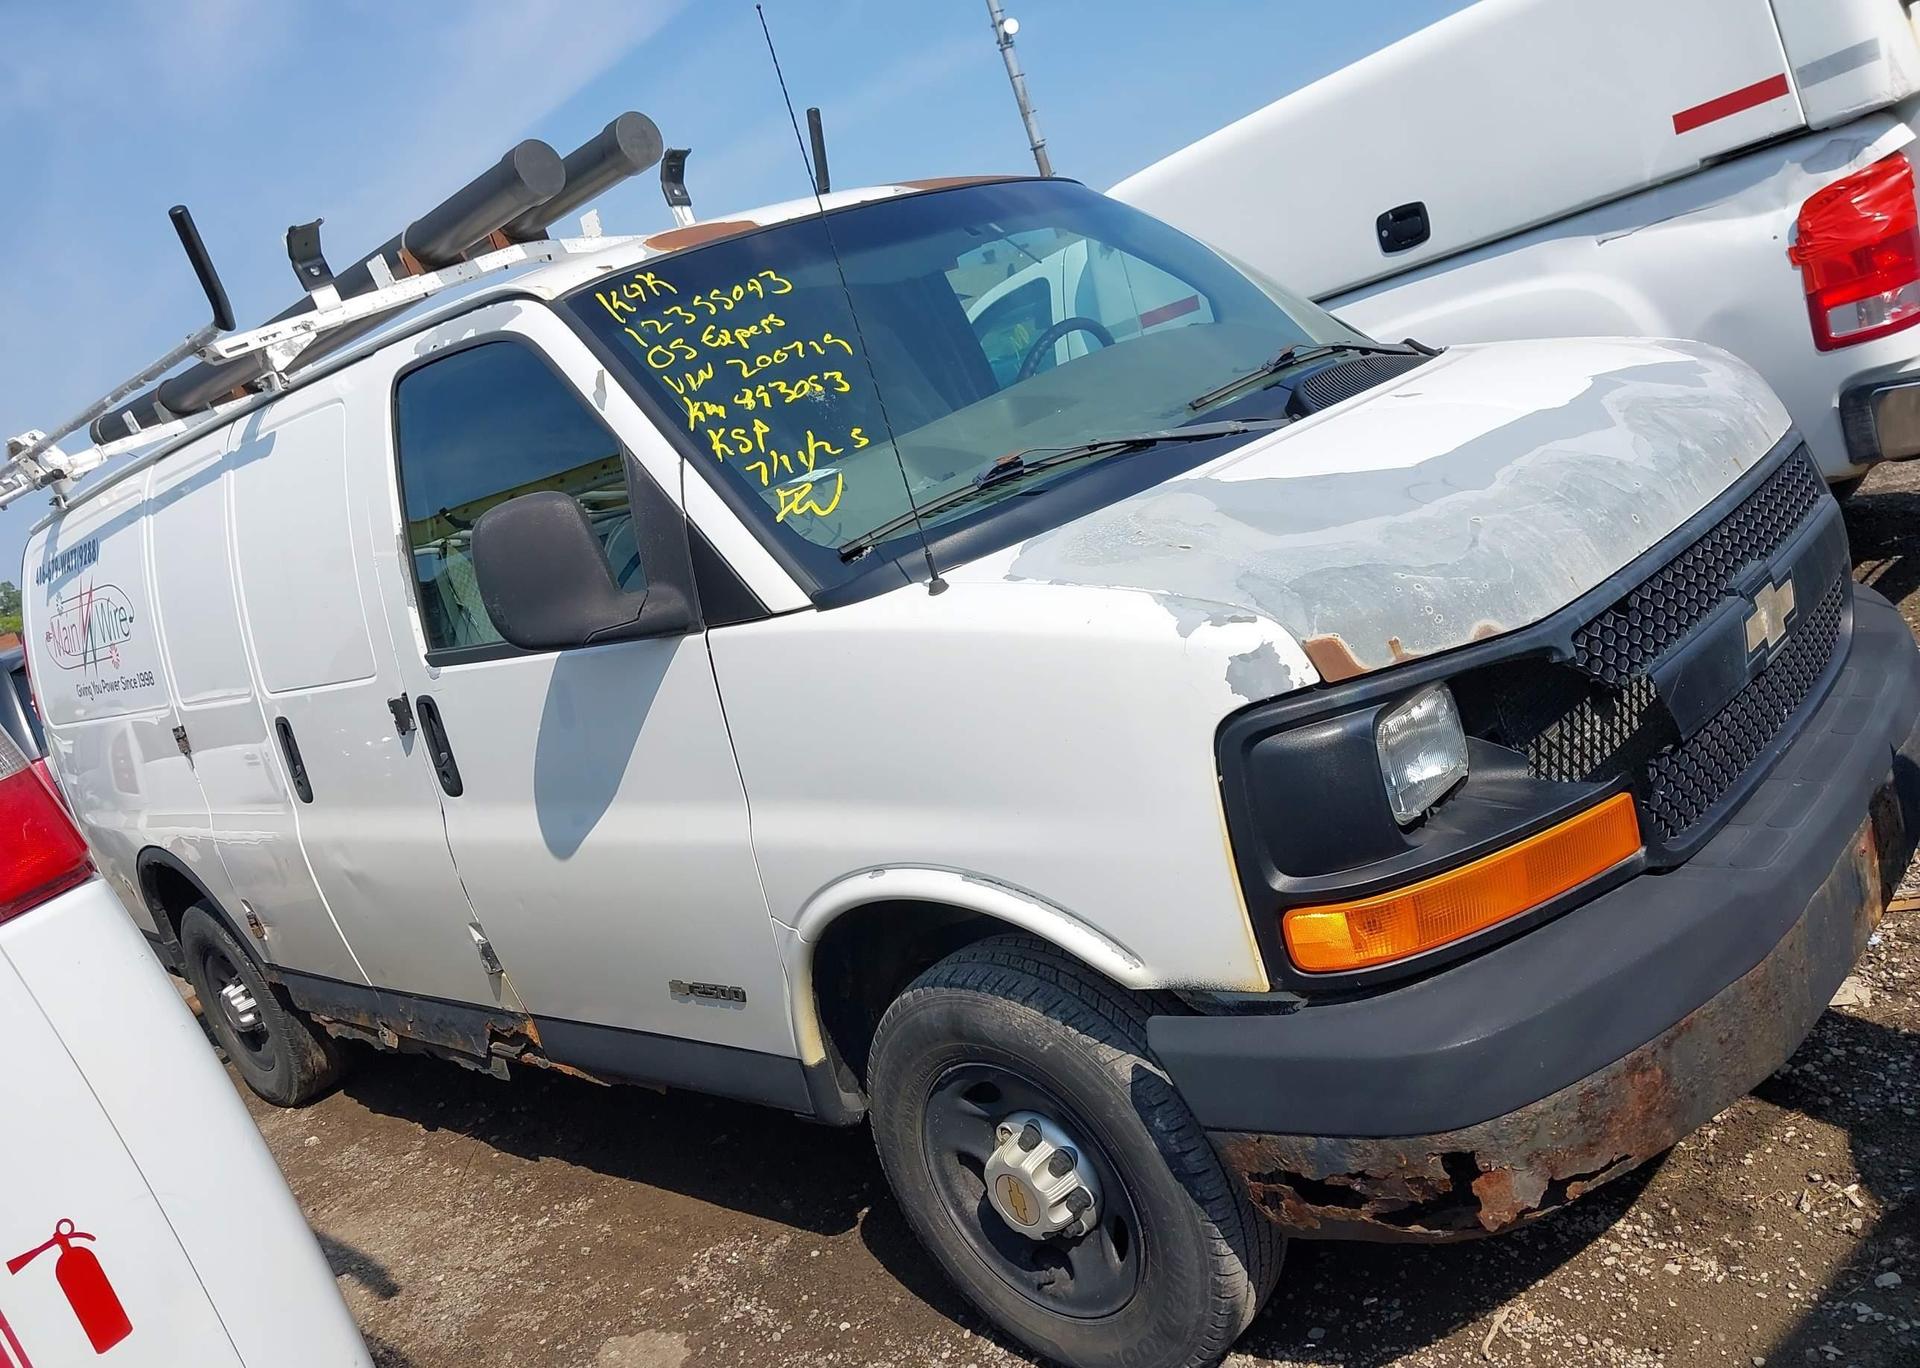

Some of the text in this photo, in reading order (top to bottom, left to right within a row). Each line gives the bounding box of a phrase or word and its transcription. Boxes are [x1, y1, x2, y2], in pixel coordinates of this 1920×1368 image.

[49, 597, 130, 658] Main Wire
[76, 670, 155, 701] Giving You Power Since 1998
